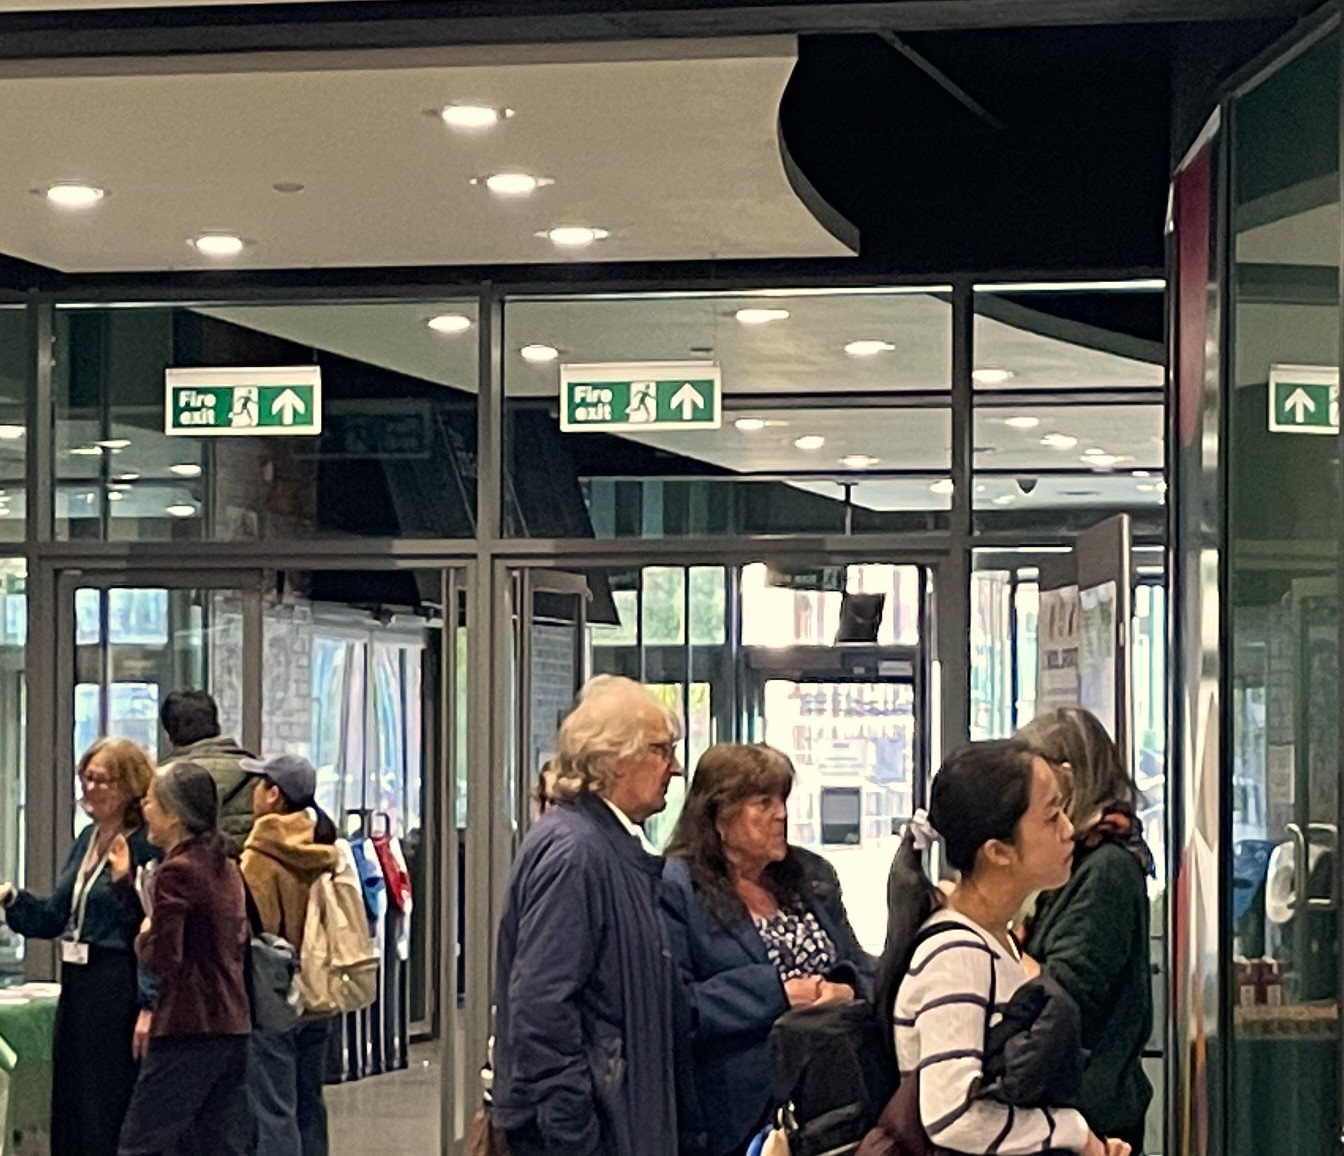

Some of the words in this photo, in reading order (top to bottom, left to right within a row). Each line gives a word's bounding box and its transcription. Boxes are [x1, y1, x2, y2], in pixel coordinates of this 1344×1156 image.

[179, 390, 216, 408] Fire
[574, 385, 613, 404] Fire
[179, 407, 215, 425] exit
[575, 403, 611, 421] exit
